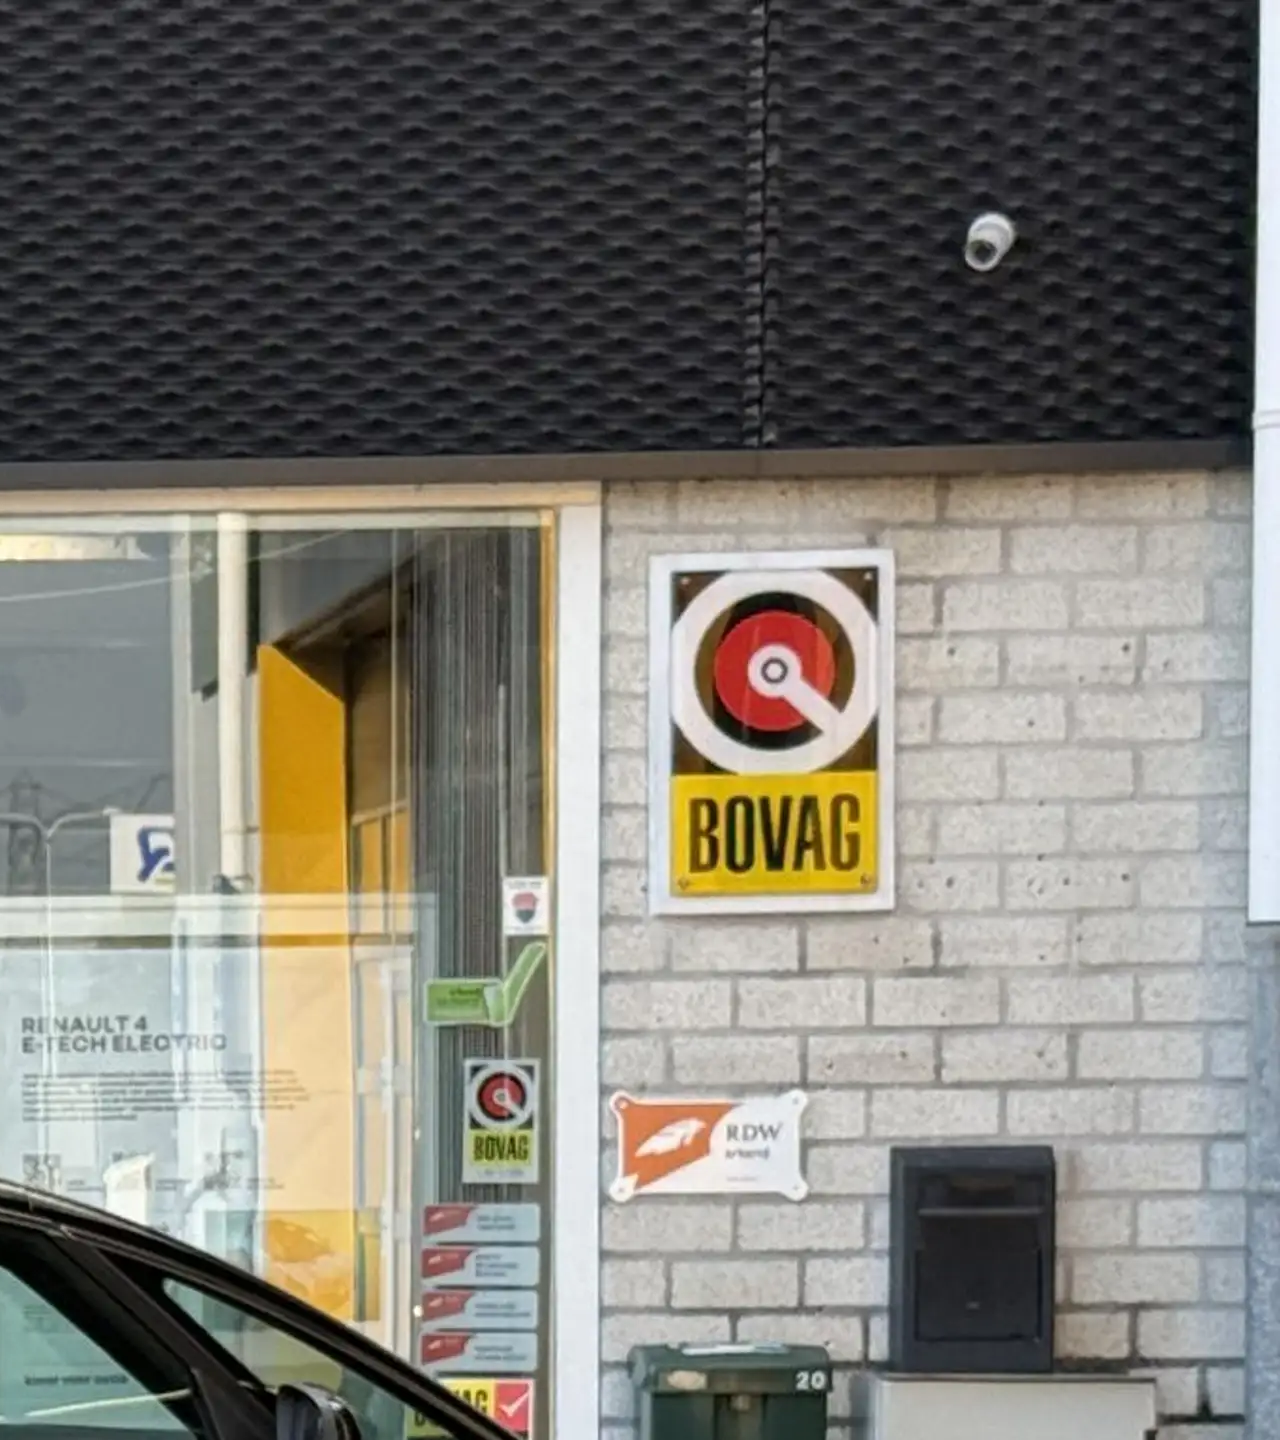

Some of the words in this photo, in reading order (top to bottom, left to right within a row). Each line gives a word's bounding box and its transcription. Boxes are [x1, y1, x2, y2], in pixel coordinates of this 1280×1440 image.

[687, 793, 862, 876] BOVAG
[20, 1015, 130, 1034] RENAULT
[133, 1015, 148, 1034] 4
[20, 1034, 106, 1054] E-TECH
[112, 1033, 227, 1053] ELECTRIC
[725, 1121, 784, 1142] RDW
[473, 1135, 529, 1161] BOVAG
[794, 1369, 827, 1391] 20
